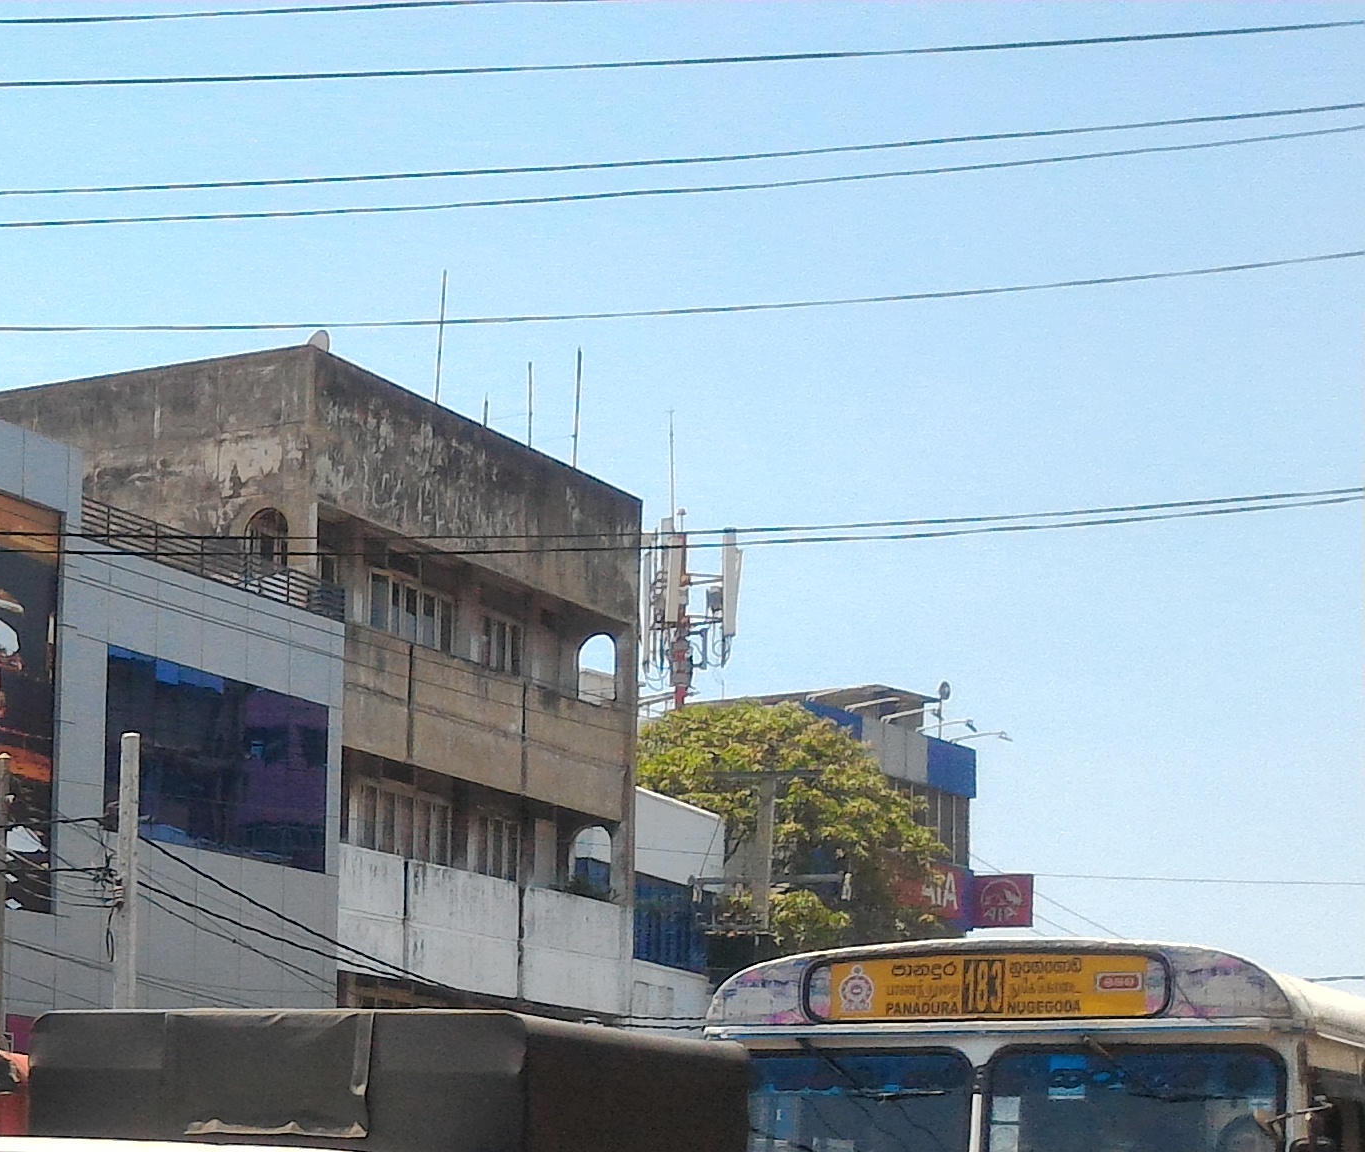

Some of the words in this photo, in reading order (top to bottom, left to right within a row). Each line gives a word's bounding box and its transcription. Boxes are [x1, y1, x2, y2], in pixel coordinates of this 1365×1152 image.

[965, 960, 1005, 1013] 183
[886, 1001, 959, 1015] PANADURA
[1007, 1000, 1081, 1015] NUGEGODA
